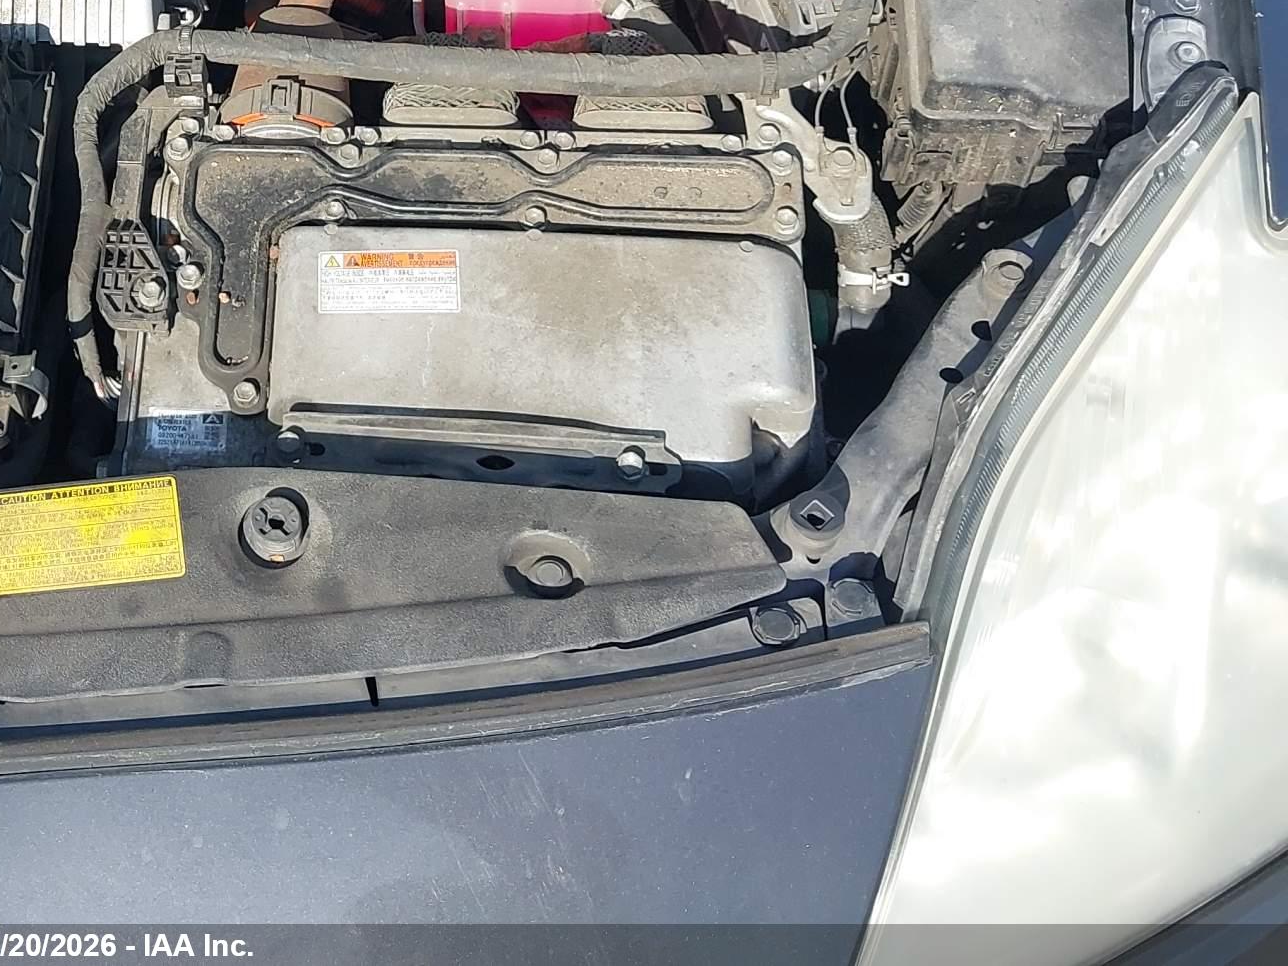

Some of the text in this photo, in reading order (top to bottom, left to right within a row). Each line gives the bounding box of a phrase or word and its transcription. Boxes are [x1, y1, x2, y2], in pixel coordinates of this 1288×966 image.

[1, 493, 46, 506] CAUTION
[52, 487, 110, 500] ATTENTION
[113, 479, 171, 492] ВНИМАНИЕ
